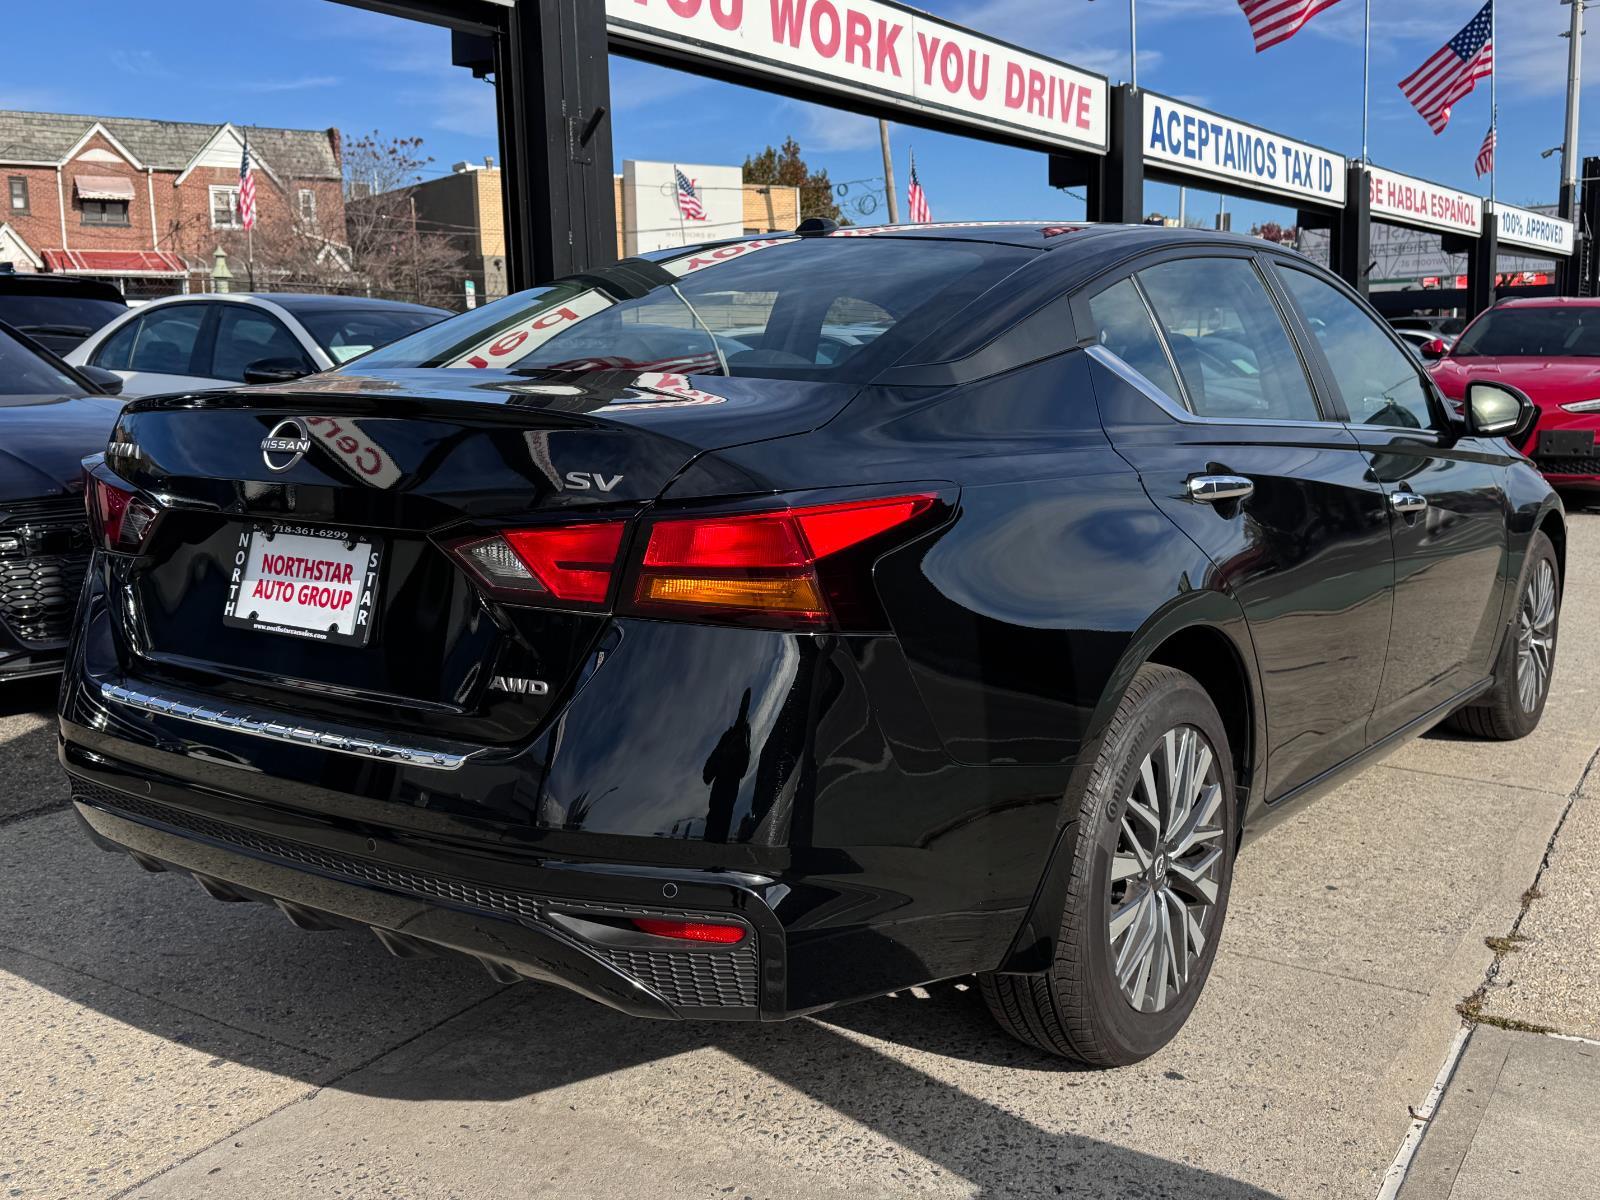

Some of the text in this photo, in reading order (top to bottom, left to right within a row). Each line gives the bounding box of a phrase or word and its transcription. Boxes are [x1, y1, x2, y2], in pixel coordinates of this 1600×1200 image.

[769, 0, 904, 77] WORK
[917, 32, 990, 101] YOU
[1004, 61, 1092, 130] DRIVE
[1150, 105, 1333, 193] ACEPTAMOS TAX ID
[1388, 181, 1428, 214] HABLA
[1431, 194, 1476, 227] ESPAÑOL
[1502, 212, 1564, 245] 100% APPROVED
[261, 439, 311, 451] NISSAN
[564, 471, 624, 492] SV
[272, 524, 349, 540] 718-361-6299
[224, 532, 250, 617] NORTH
[261, 553, 353, 585] NORTHSTAR
[252, 578, 353, 611] AUTO GROUP
[357, 552, 379, 626] STAR
[488, 675, 549, 696] AWD
[1104, 721, 1149, 823] Continental
